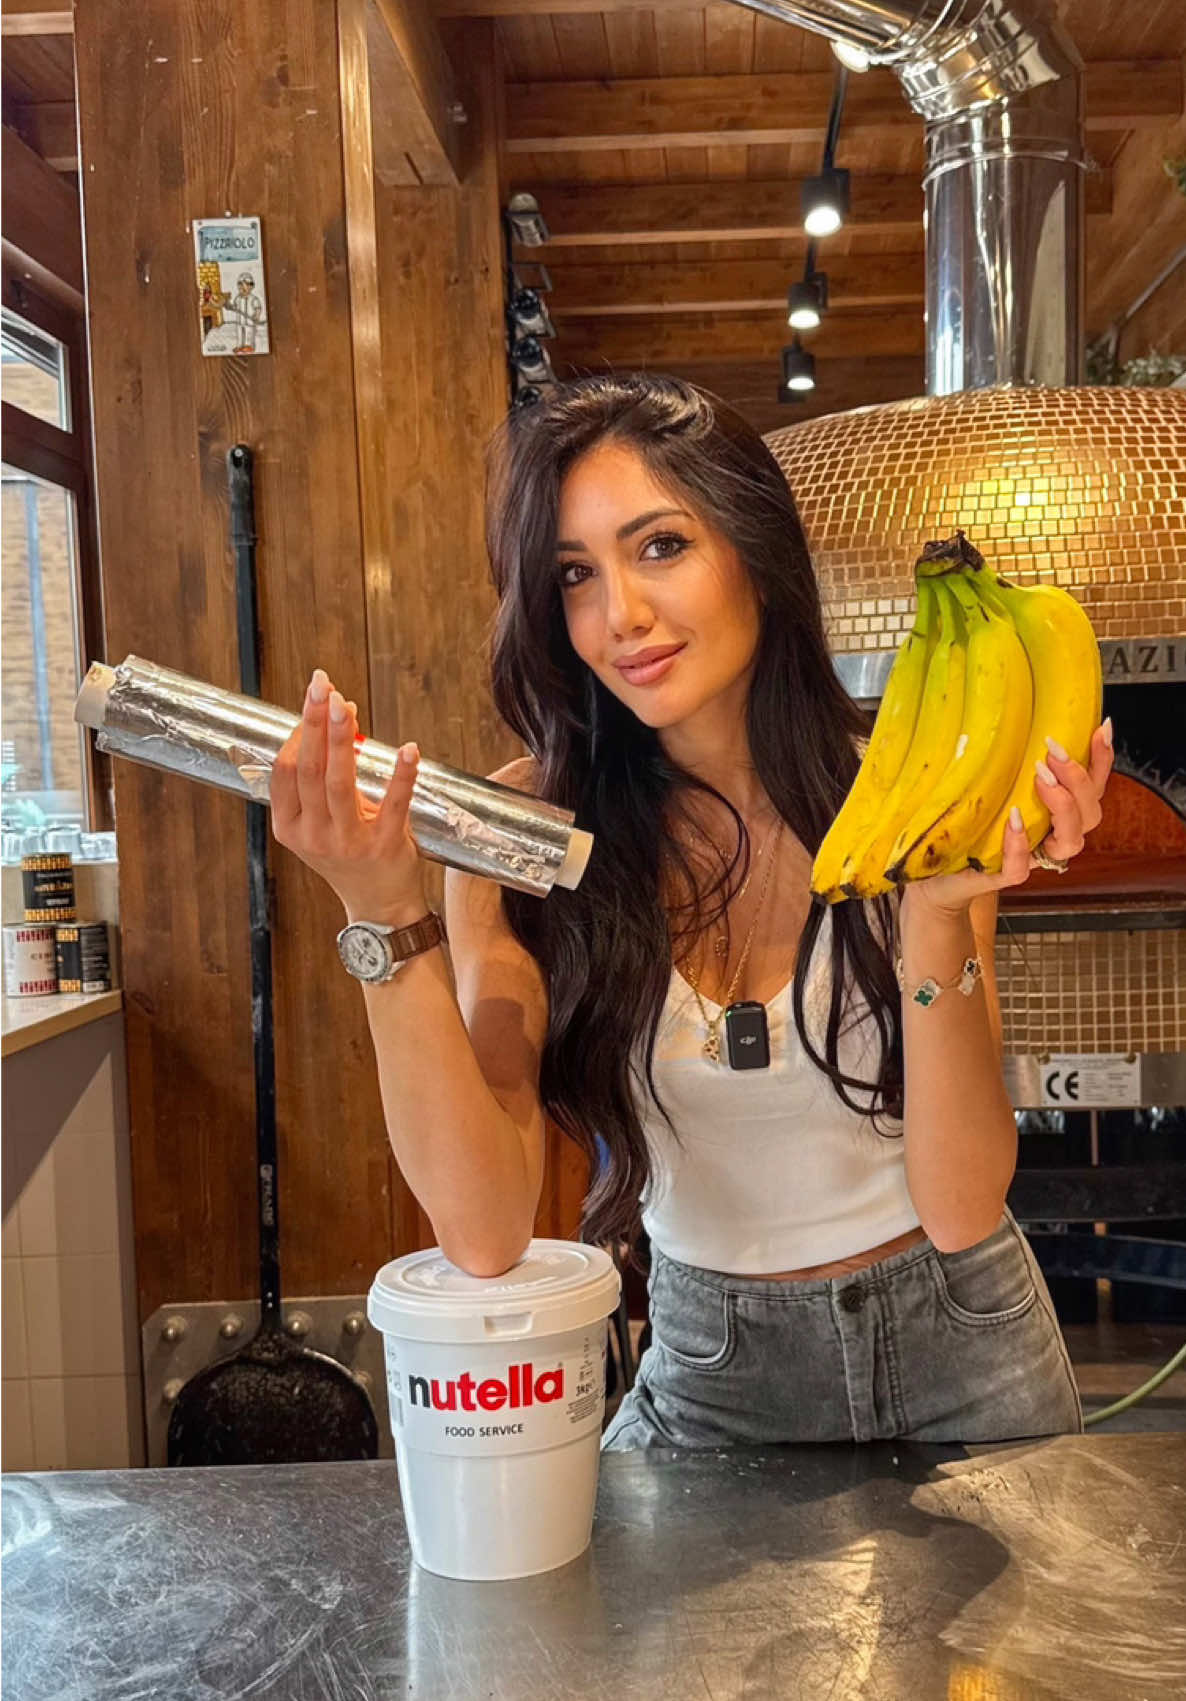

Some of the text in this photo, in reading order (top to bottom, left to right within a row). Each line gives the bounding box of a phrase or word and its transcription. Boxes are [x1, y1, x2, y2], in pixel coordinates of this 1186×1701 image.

[1108, 645, 1186, 674] AZI
[1046, 1071, 1079, 1100] CE
[408, 1363, 564, 1411] nutella
[445, 1423, 524, 1438] FOOD SERVICE
